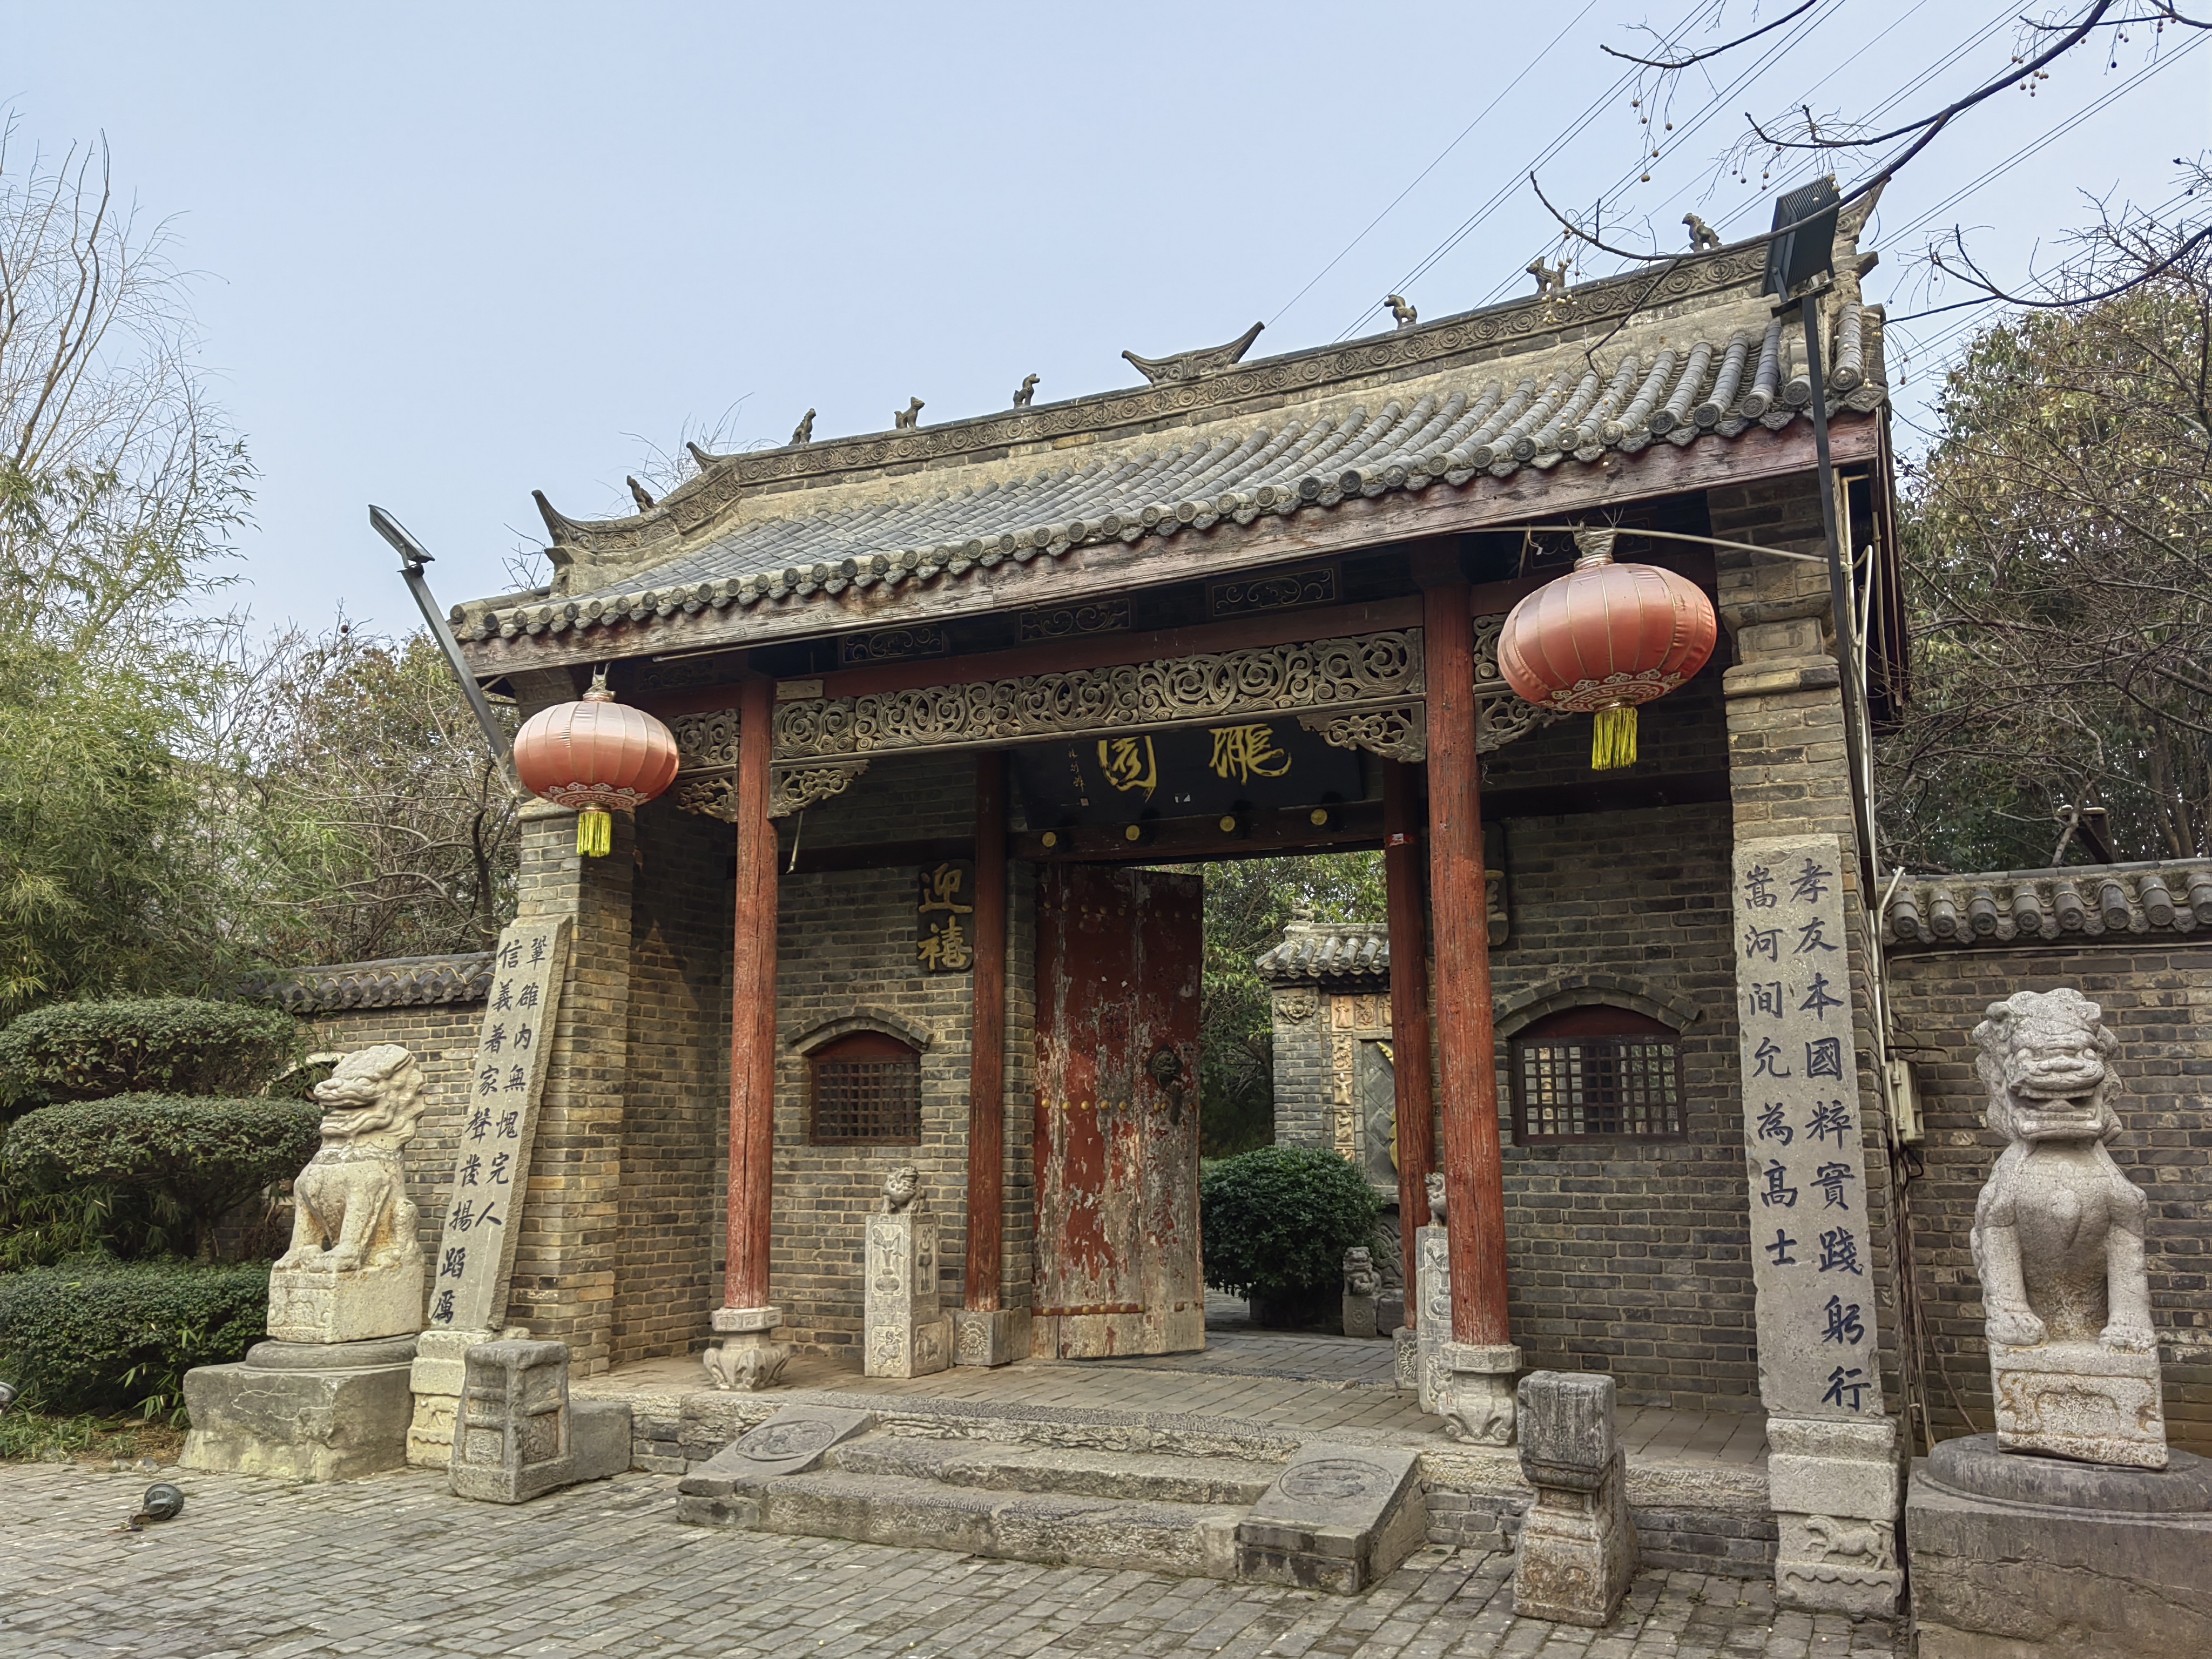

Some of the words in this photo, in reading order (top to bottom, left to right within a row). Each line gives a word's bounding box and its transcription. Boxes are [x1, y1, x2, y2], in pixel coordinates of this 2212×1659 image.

[1790, 858, 1871, 1412] 孝友本國粹實踐躬行
